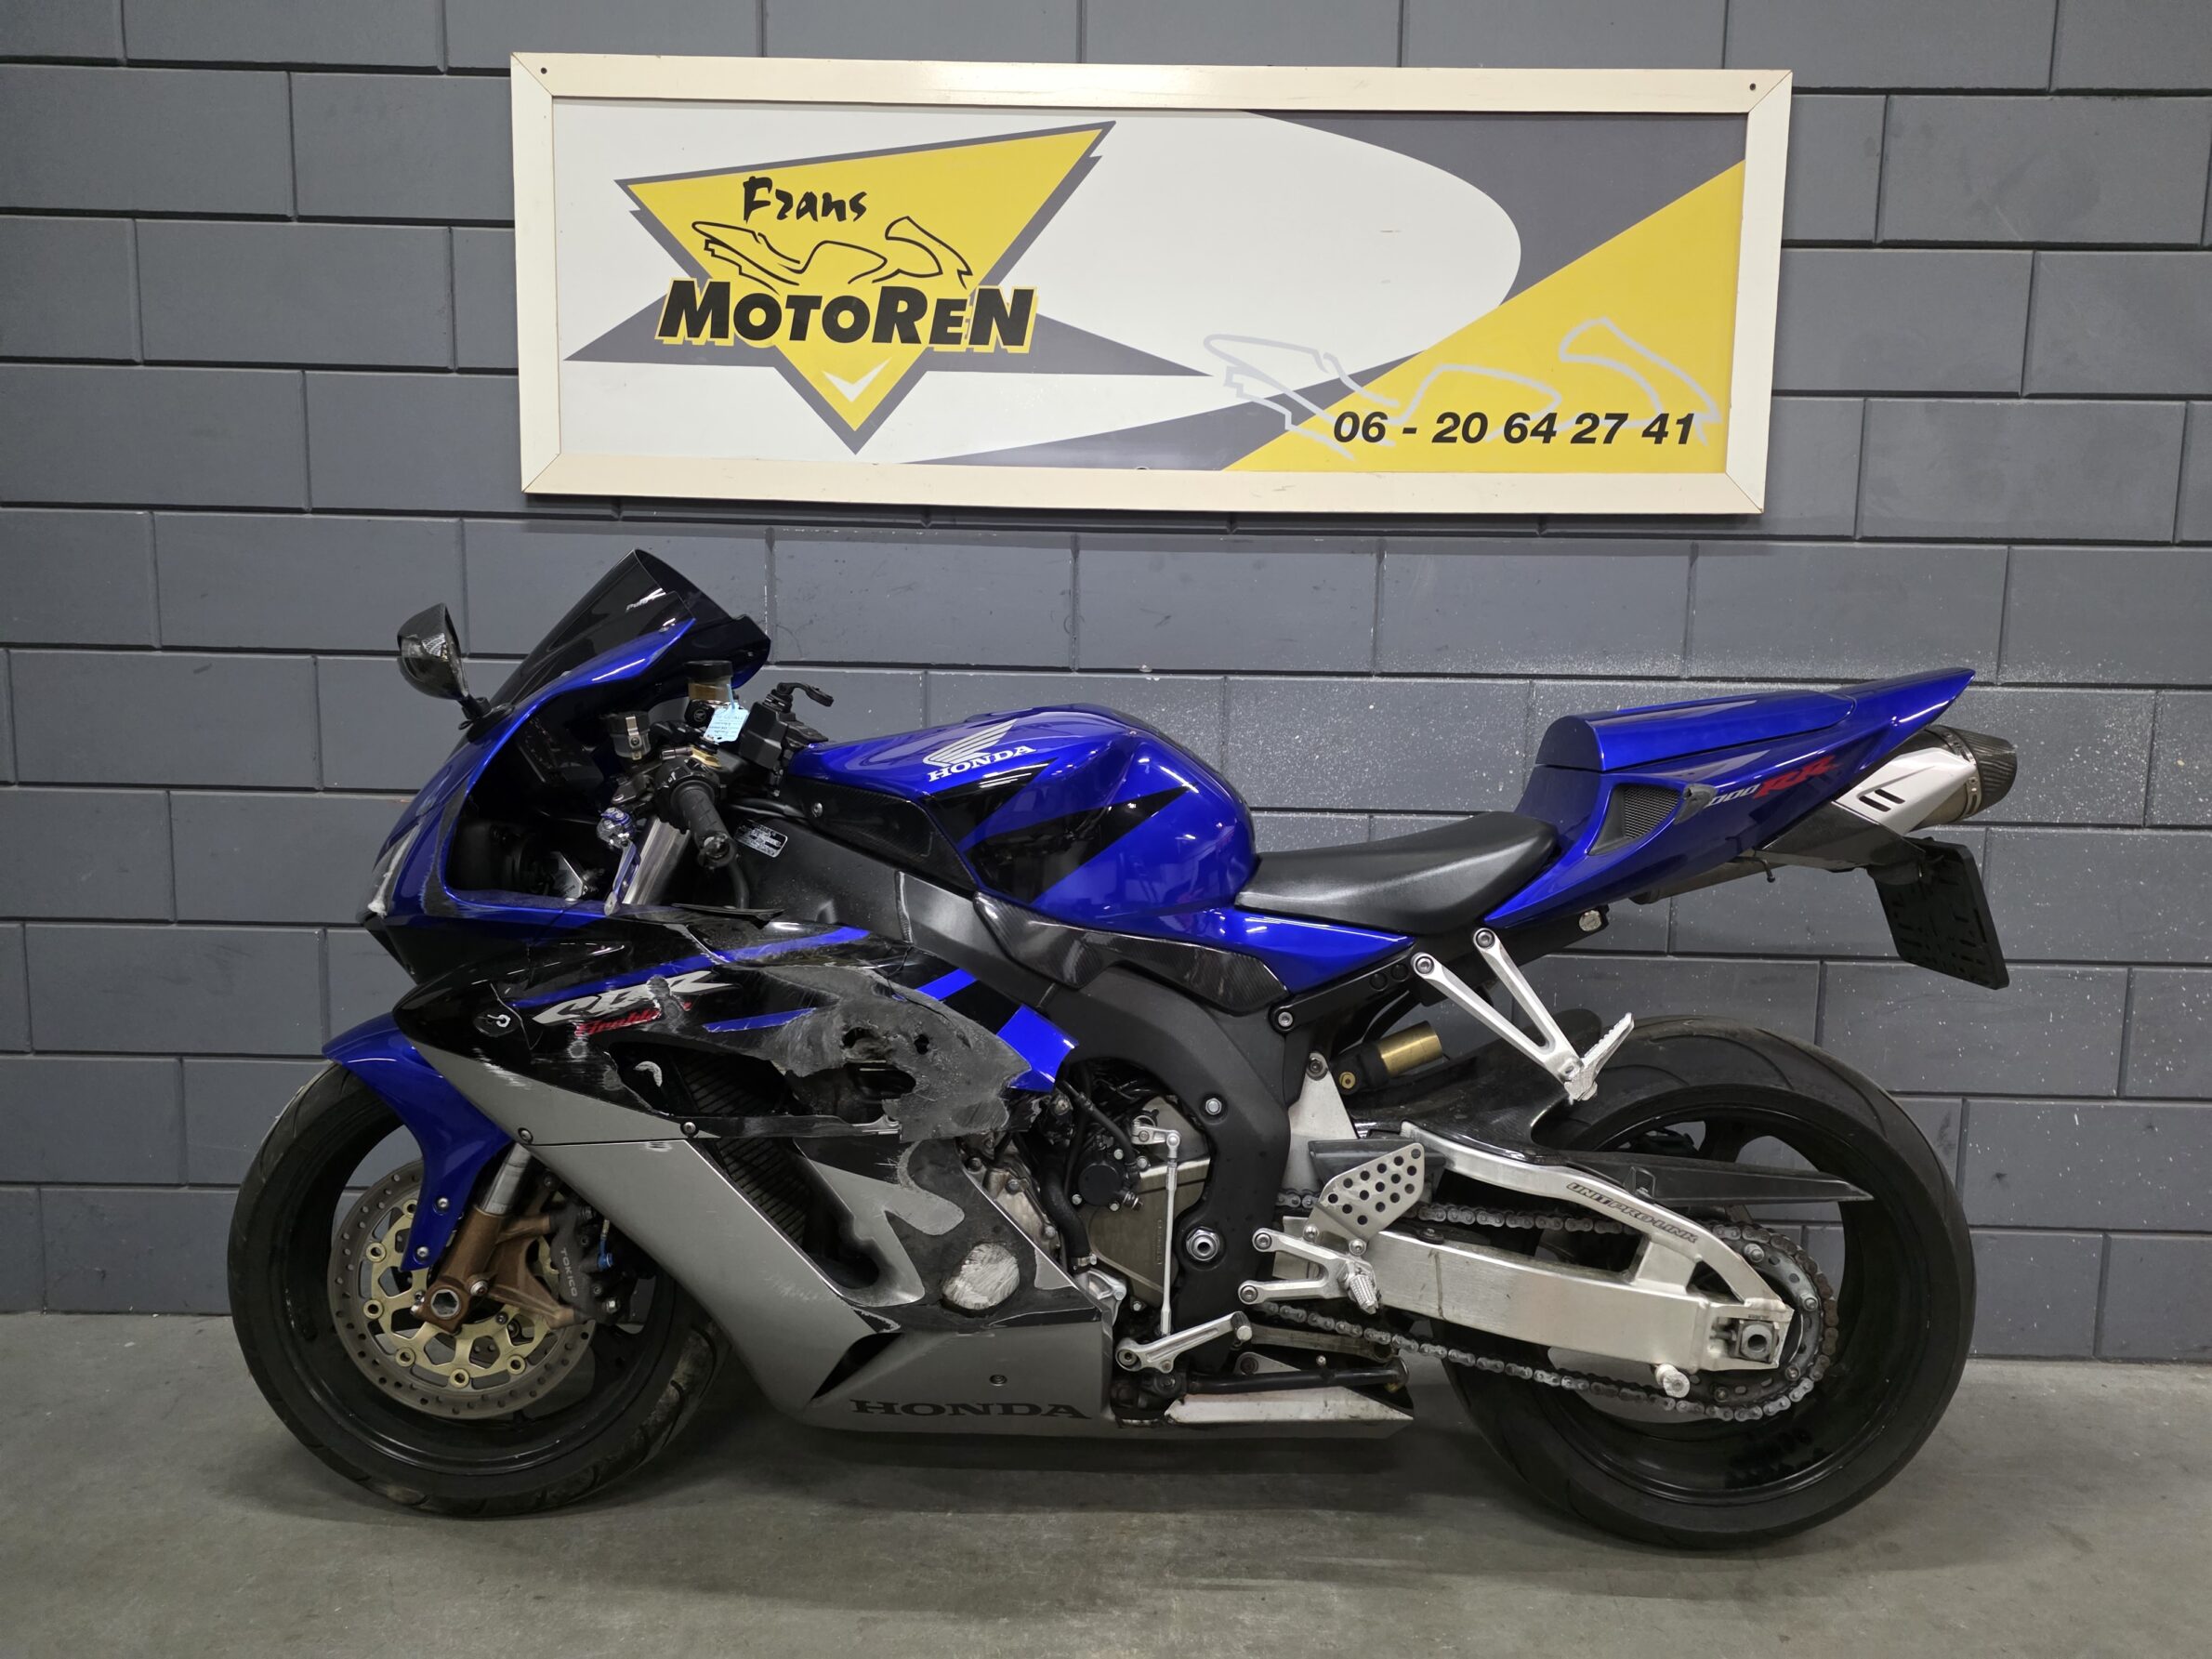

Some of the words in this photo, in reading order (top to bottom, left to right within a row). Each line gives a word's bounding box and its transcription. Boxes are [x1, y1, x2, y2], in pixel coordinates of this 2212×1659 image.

[743, 176, 867, 225] Frans
[1333, 411, 1389, 443] 06
[1402, 426, 1417, 435] -
[1431, 411, 1489, 444] 20
[1502, 412, 1558, 444] 64
[1570, 412, 1628, 445] 27
[1641, 412, 1695, 445] 41
[927, 745, 1037, 783] HONDA
[1566, 1181, 1610, 1209] UNIT
[1608, 1200, 1699, 1244] PRO-LINK
[560, 1247, 578, 1297] TOKICO
[849, 1399, 1093, 1419] HONDA
